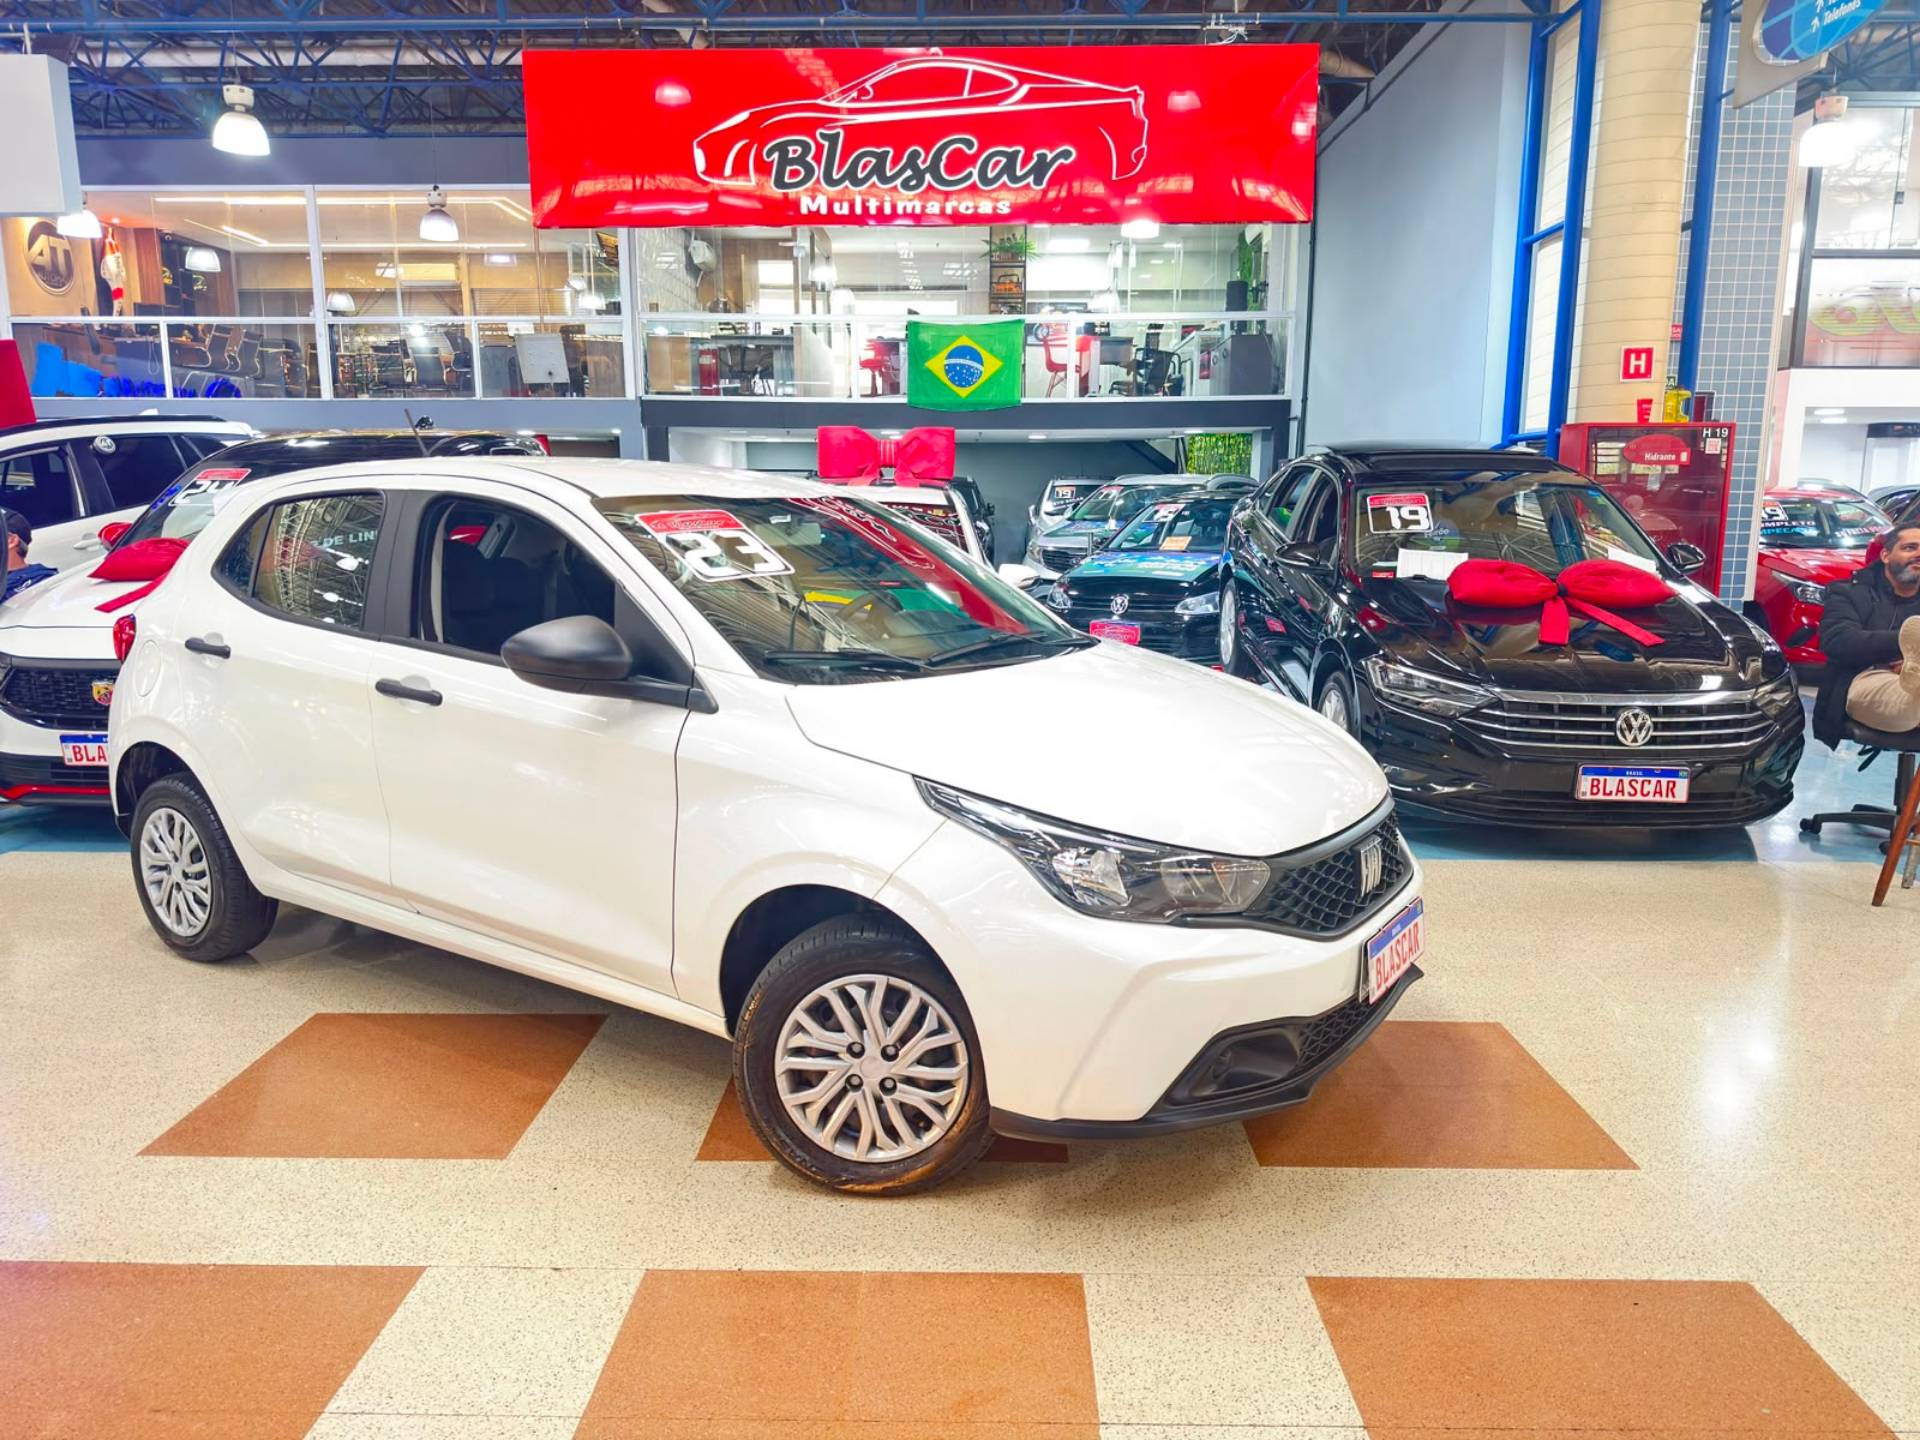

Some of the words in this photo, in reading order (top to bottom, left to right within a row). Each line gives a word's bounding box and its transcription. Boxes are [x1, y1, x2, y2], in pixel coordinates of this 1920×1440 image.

[764, 128, 1076, 194] BlasCar
[800, 195, 1011, 215] Multimarcas
[1629, 352, 1647, 374] H
[1702, 427, 1711, 437] H
[1715, 427, 1729, 437] 19
[1644, 451, 1676, 462] Hidrante
[1386, 506, 1430, 530] 19
[348, 529, 378, 544] LIN
[665, 530, 787, 577] 23
[72, 744, 107, 762] BLA
[1590, 778, 1677, 798] BLASCAR
[1375, 921, 1420, 990] BLASCAR
